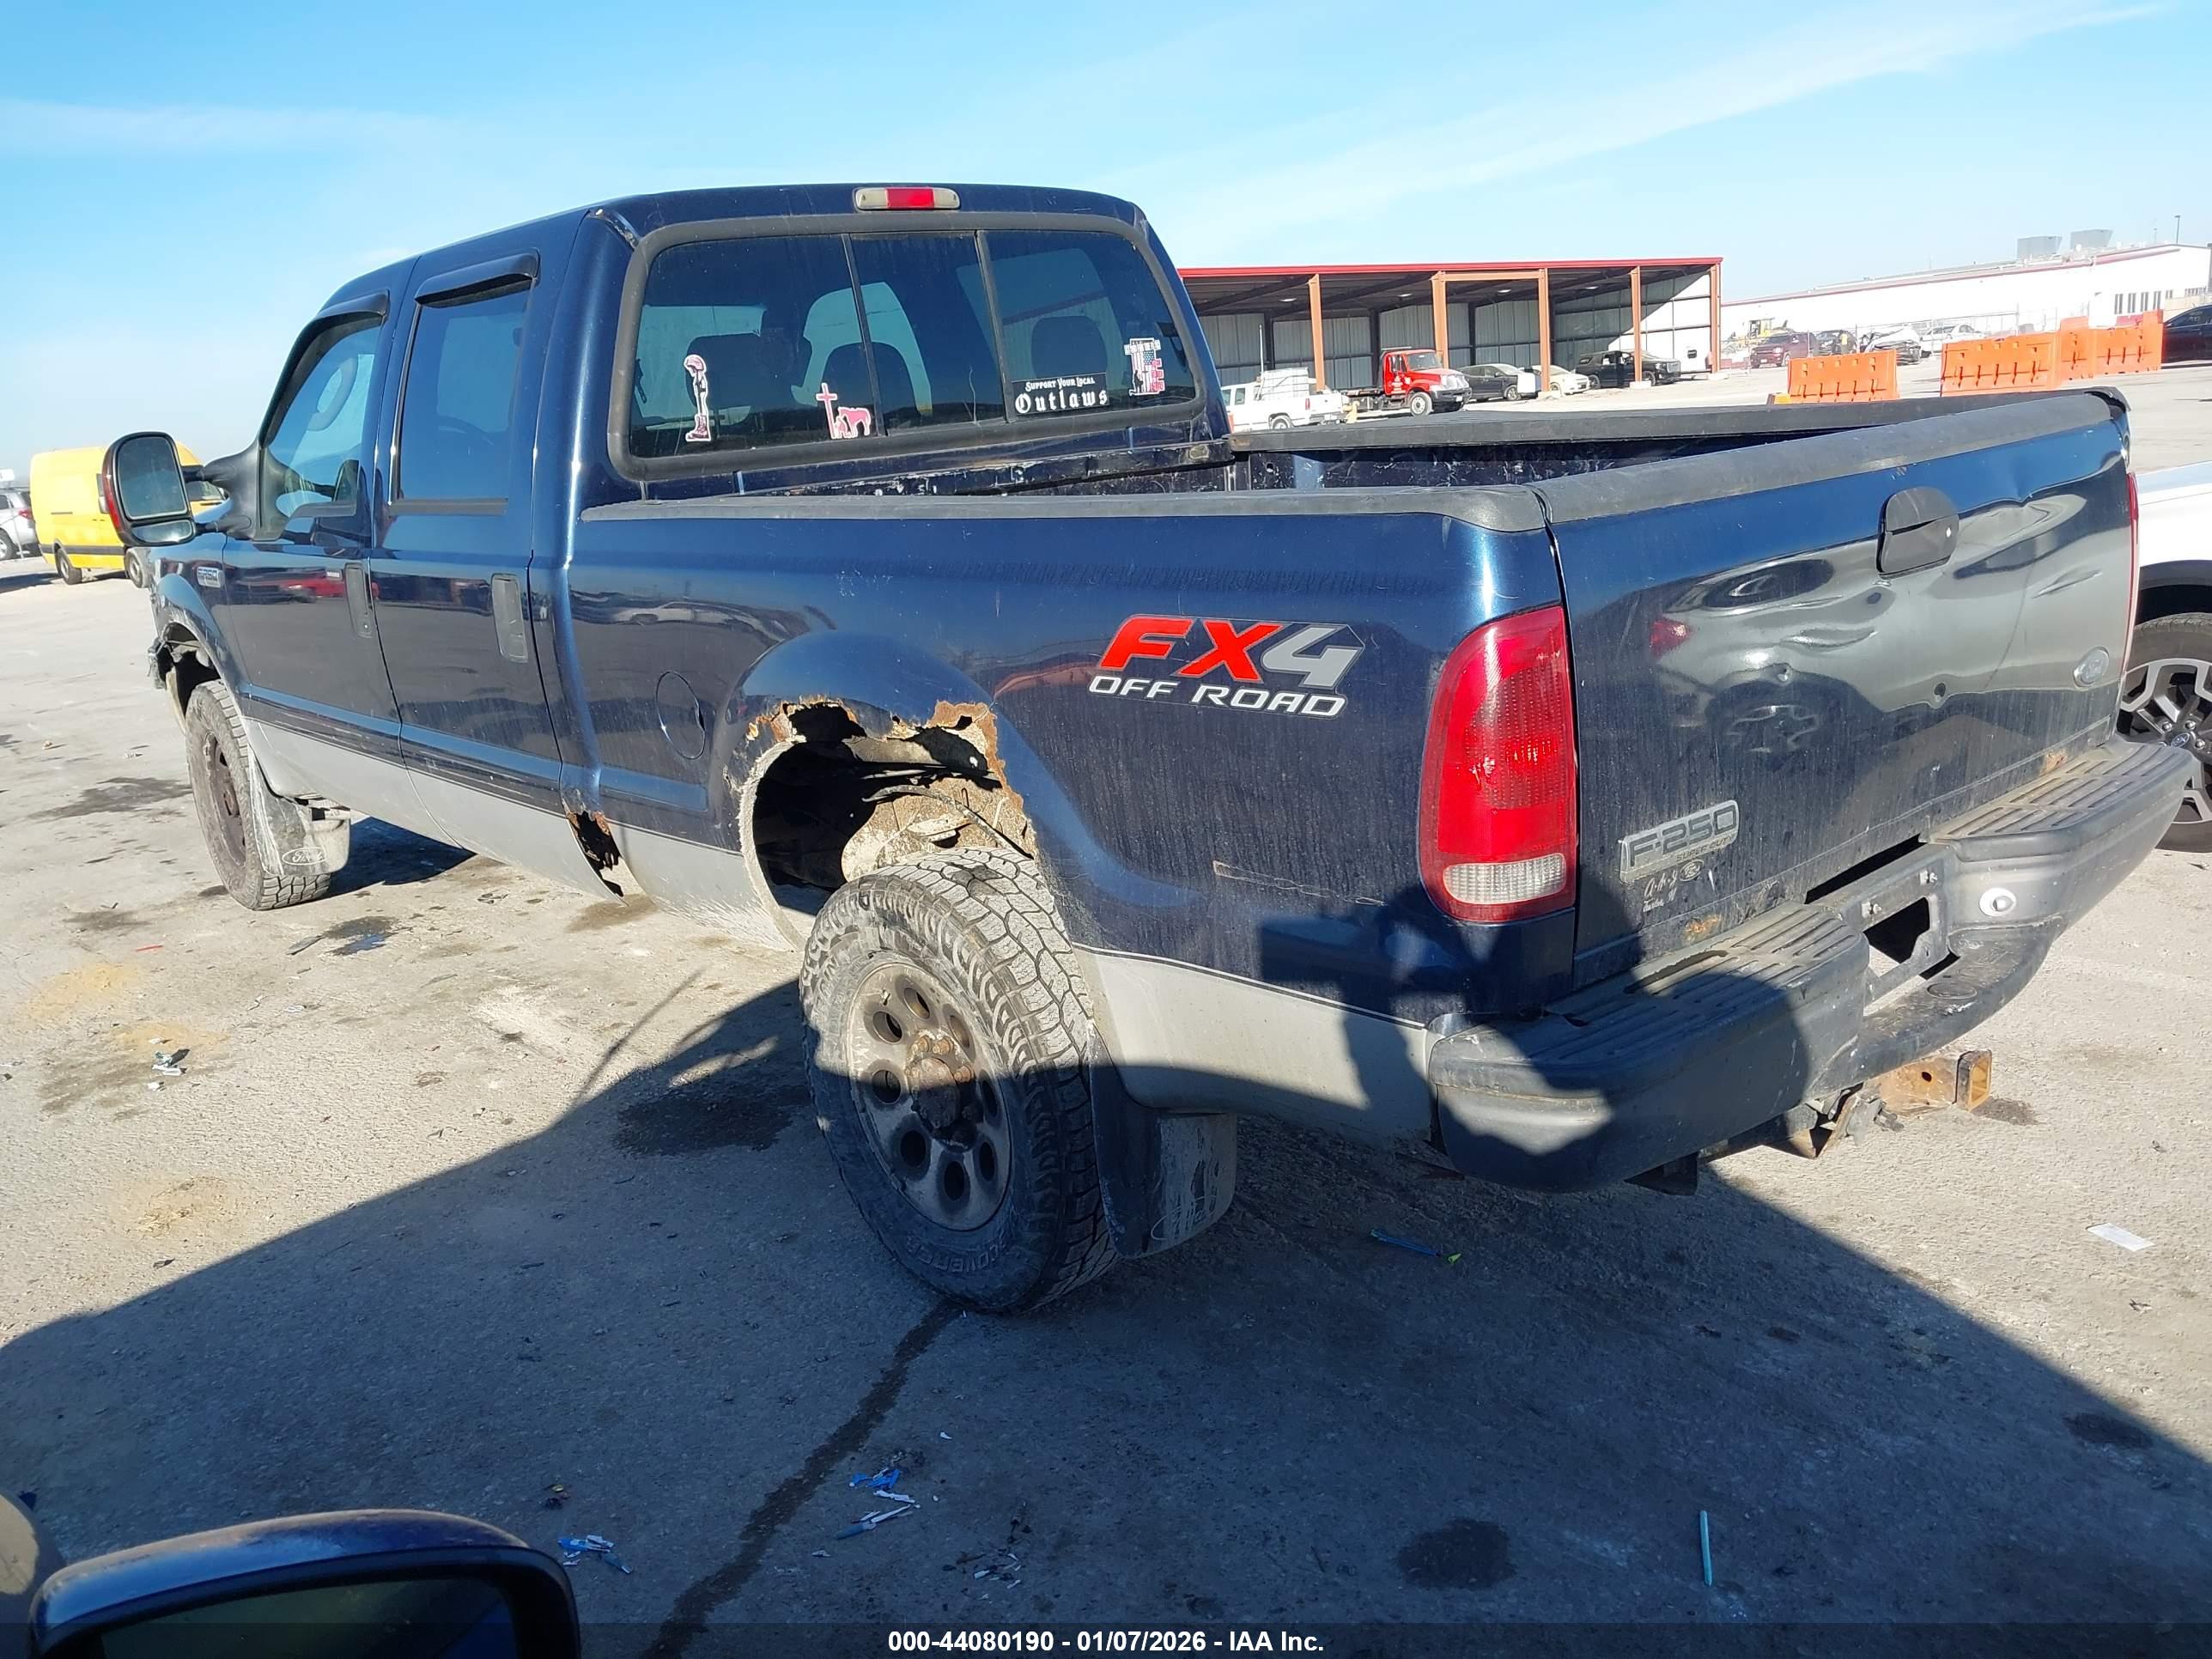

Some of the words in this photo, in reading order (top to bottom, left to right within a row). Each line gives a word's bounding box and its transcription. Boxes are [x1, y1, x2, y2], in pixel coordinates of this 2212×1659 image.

[1015, 389, 1108, 414] Outlaws
[1098, 615, 1363, 690] FX4
[1089, 675, 1180, 699] OFF
[1191, 684, 1346, 716] ROAD
